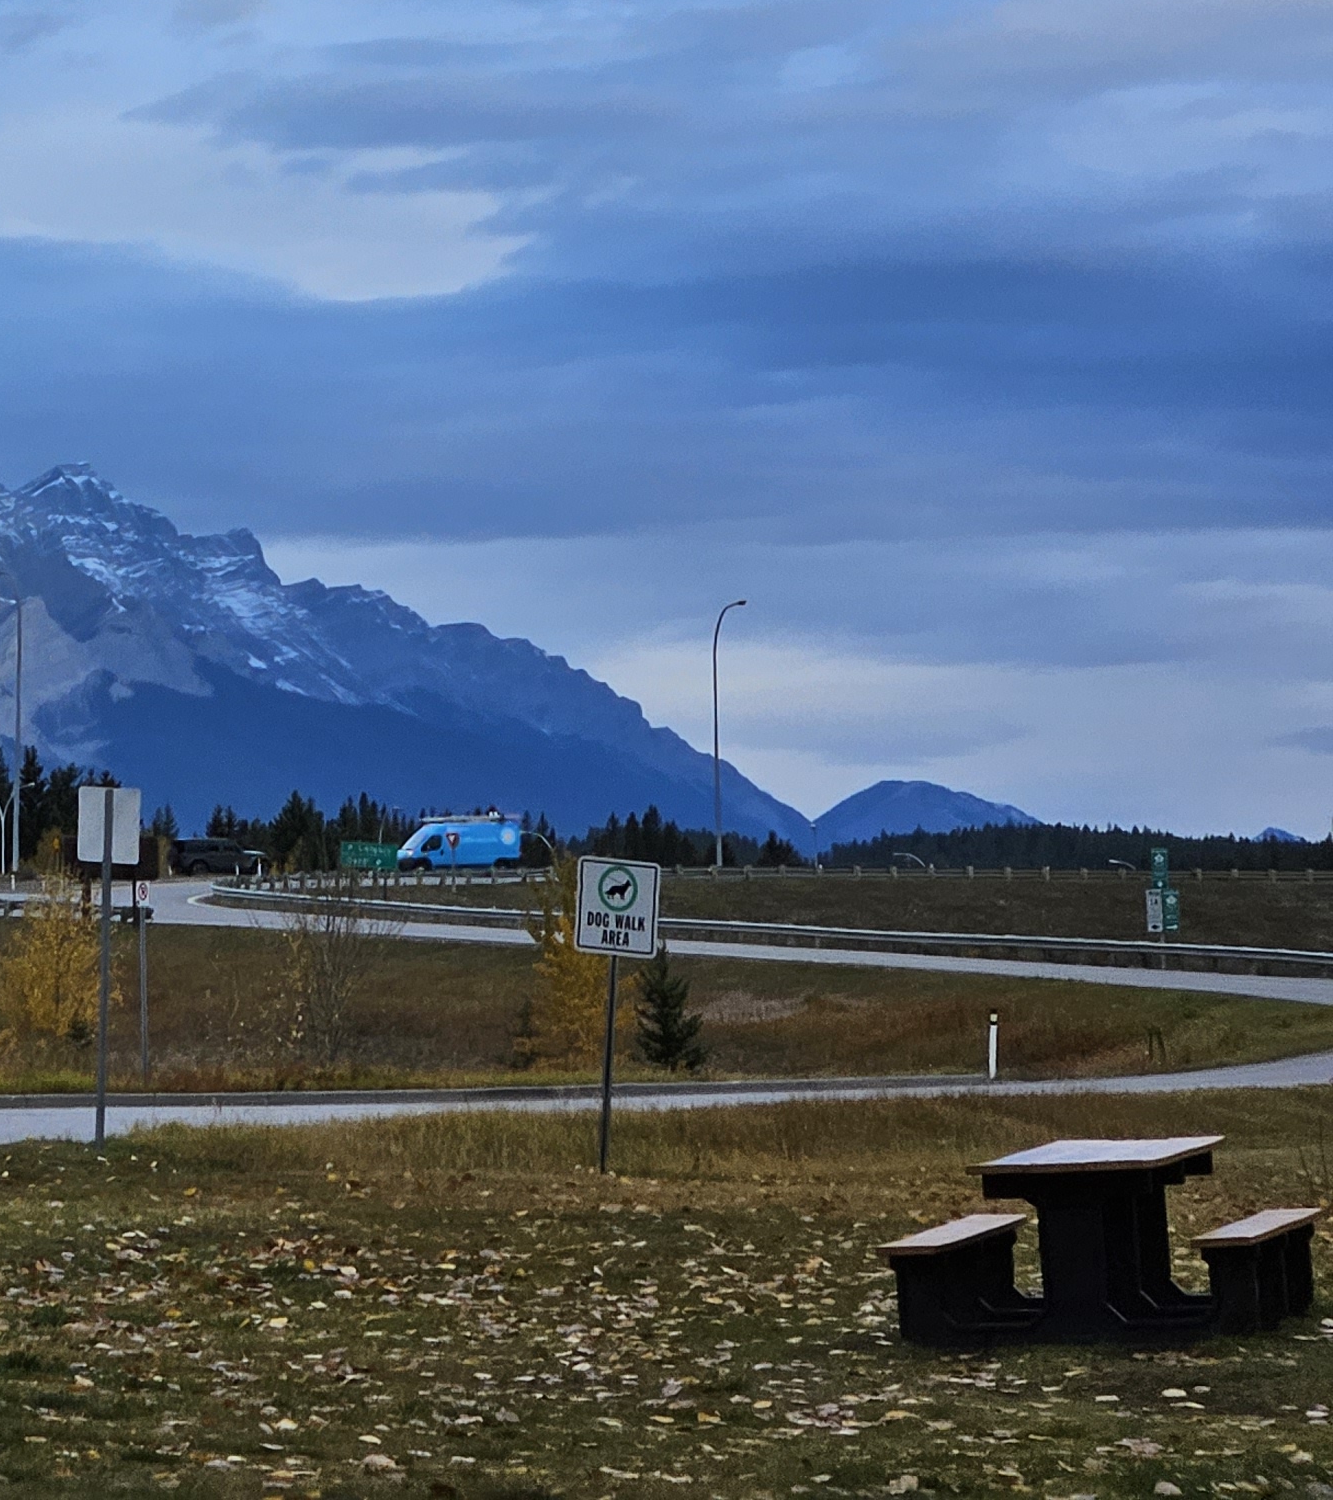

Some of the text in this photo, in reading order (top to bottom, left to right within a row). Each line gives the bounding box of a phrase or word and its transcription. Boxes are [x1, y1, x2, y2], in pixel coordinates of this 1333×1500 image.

[587, 911, 645, 932] DOG WALK
[601, 930, 630, 947] AREA
